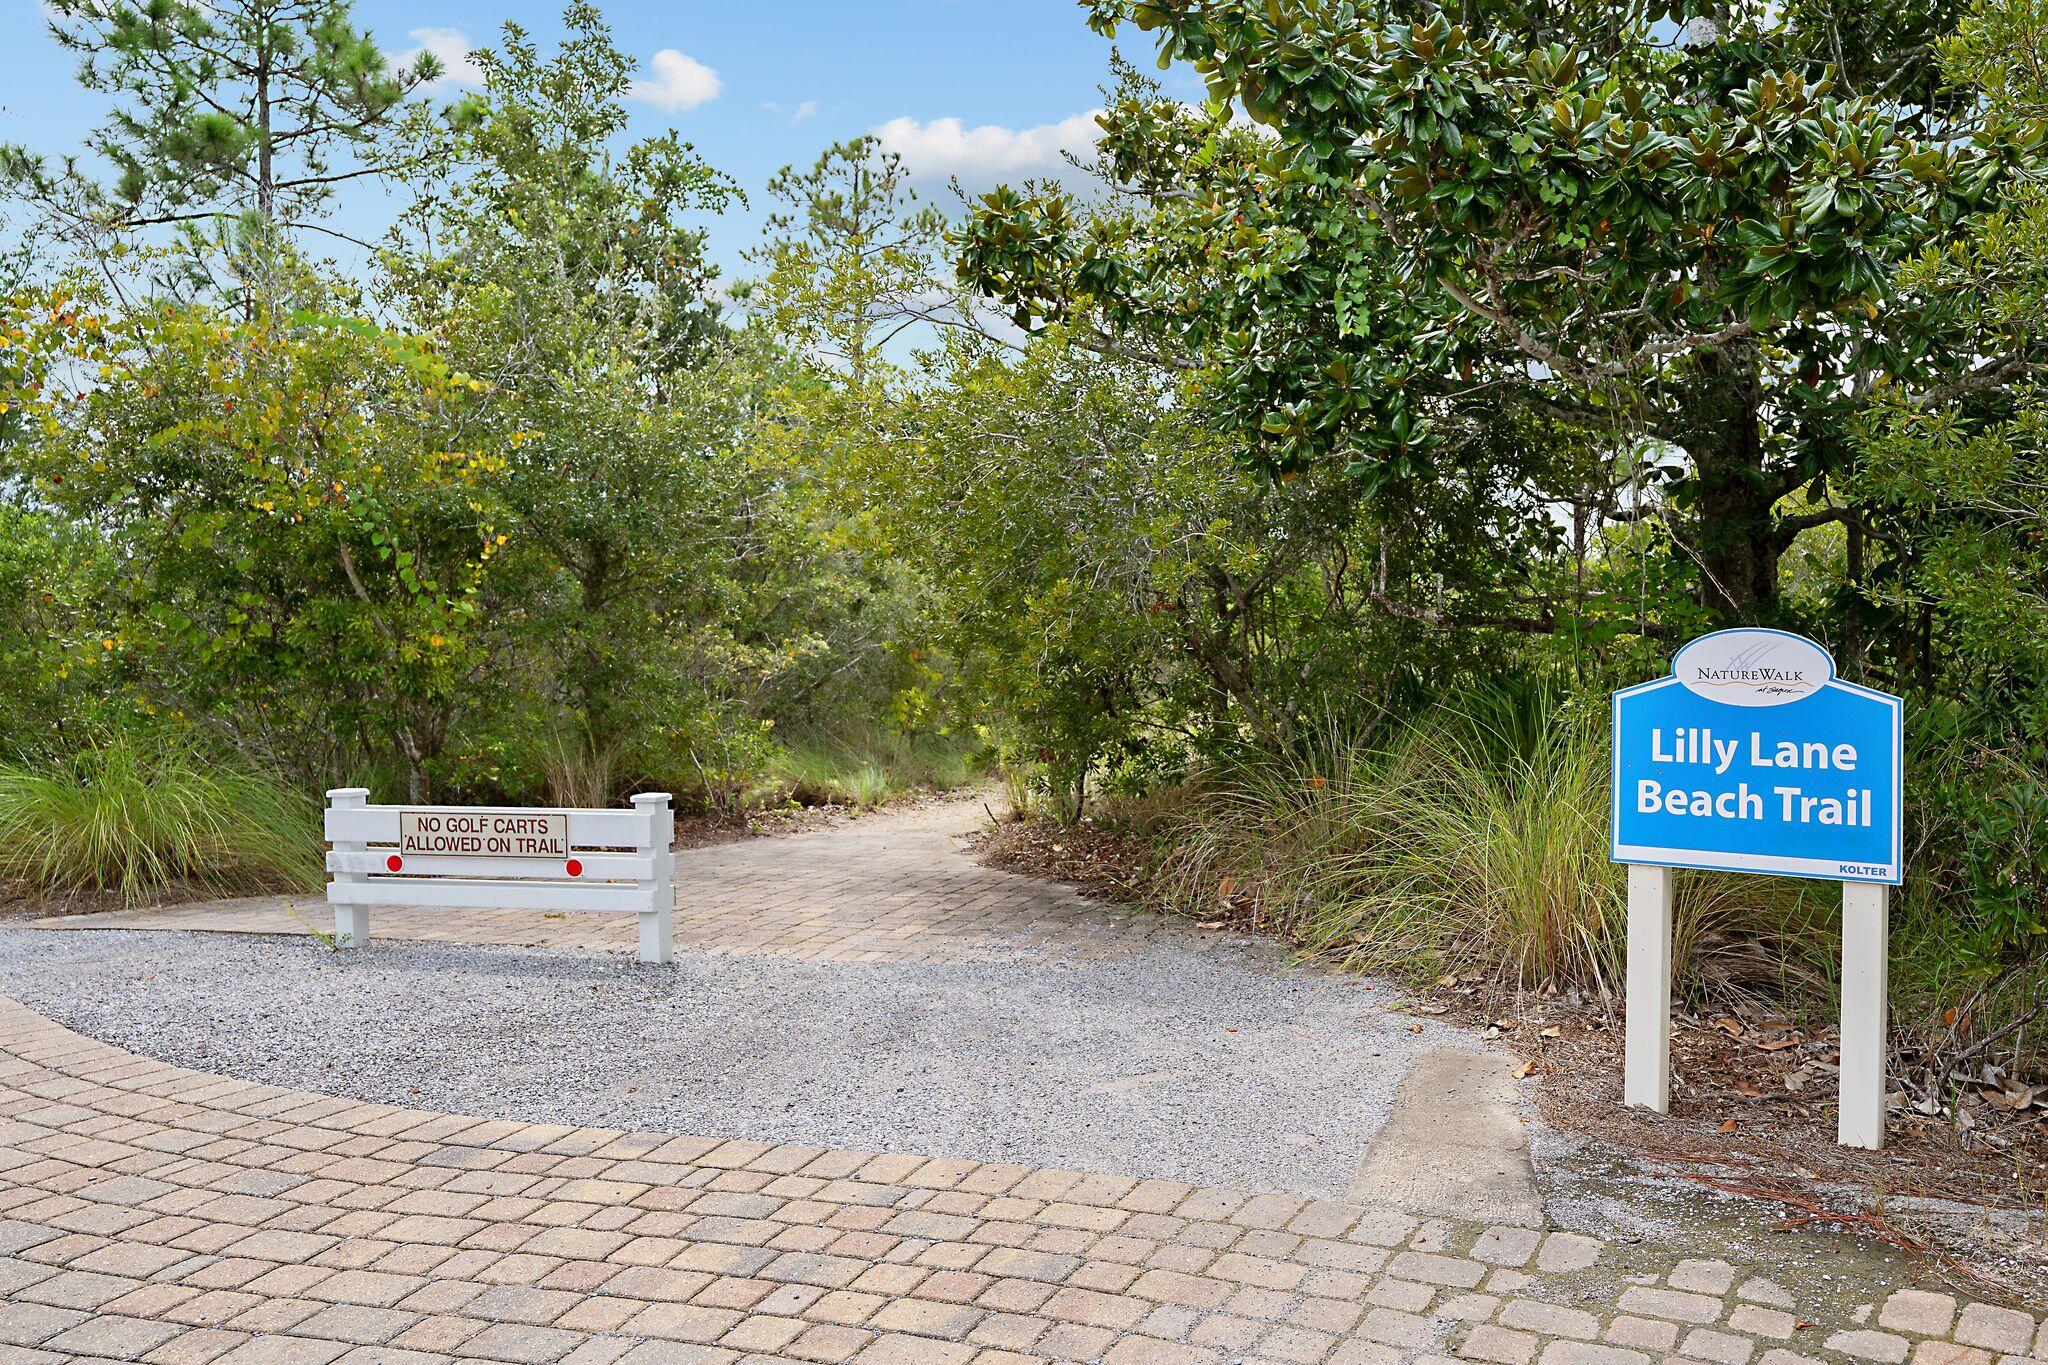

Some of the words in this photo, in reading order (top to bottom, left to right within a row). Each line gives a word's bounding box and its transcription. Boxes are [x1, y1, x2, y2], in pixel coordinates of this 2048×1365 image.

[1652, 727, 1739, 775] Lilly
[1751, 731, 1857, 771] Lane
[1637, 779, 1763, 820] Beach
[1773, 786, 1872, 827] Trail
[417, 817, 441, 833] NO
[446, 818, 488, 834] GOLF
[494, 818, 548, 835] CARTS
[405, 836, 481, 852] ALLOWED
[487, 837, 511, 853] ON
[516, 838, 564, 854] TRAIL
[1839, 864, 1887, 877] KOLTER
